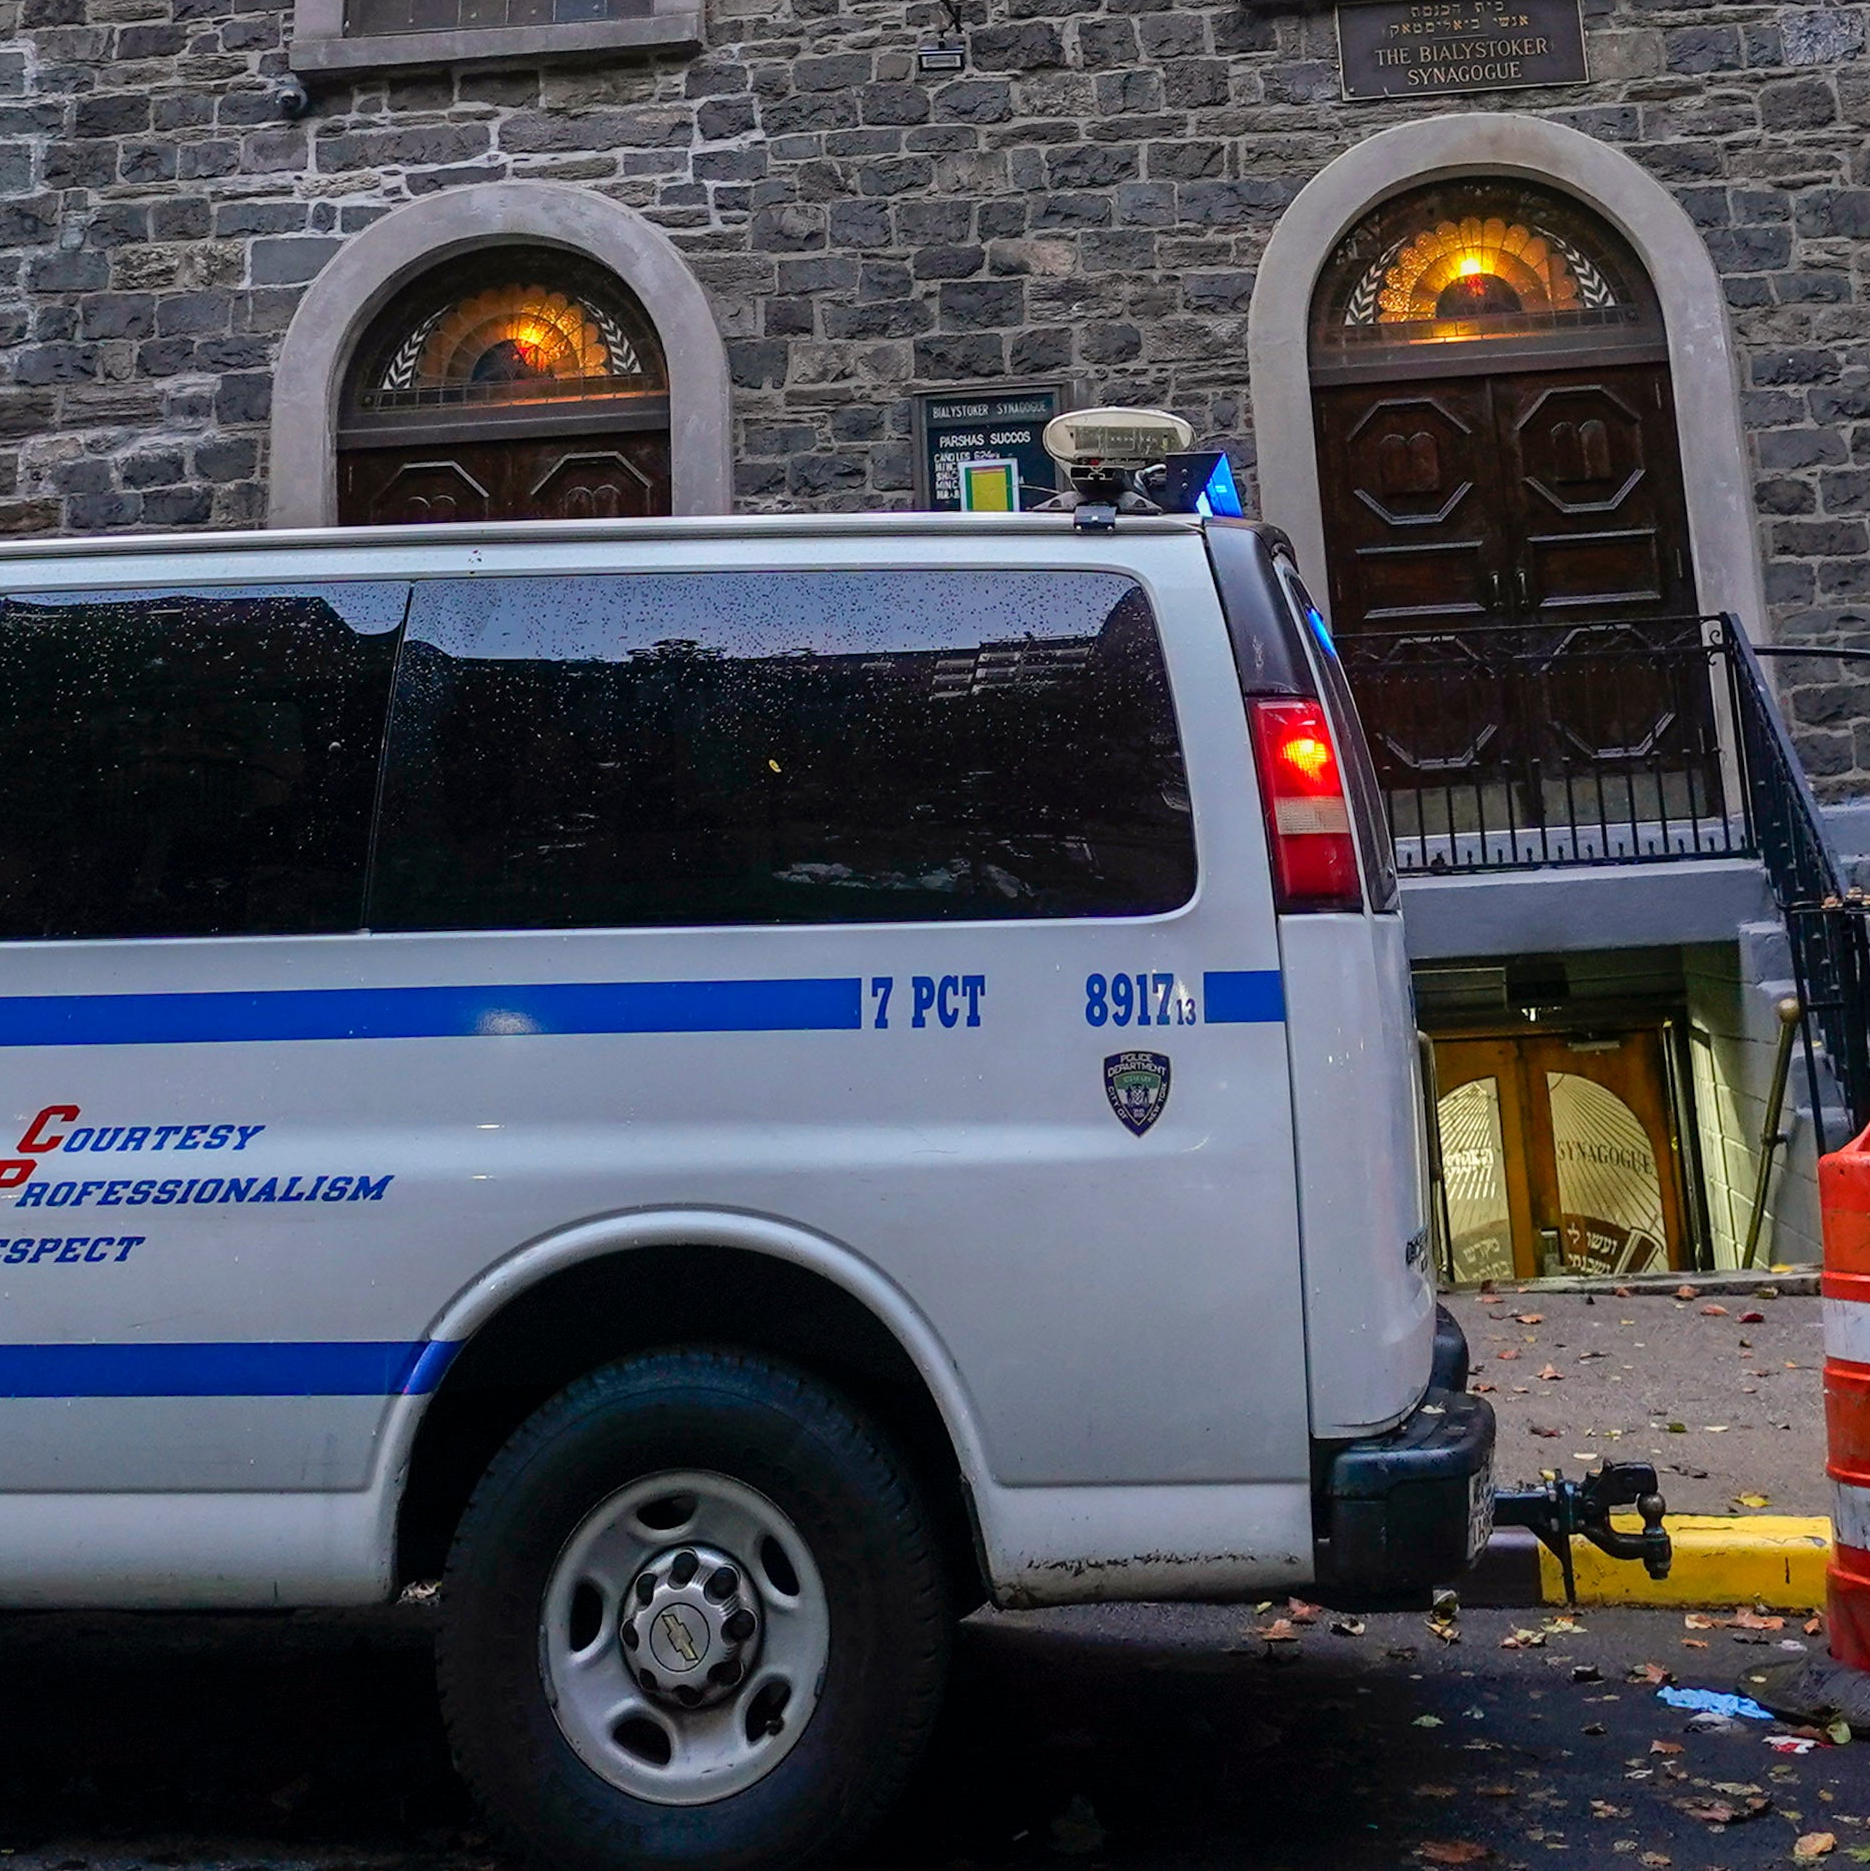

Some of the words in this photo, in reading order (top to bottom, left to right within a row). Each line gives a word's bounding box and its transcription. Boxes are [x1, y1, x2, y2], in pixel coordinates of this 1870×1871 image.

[1375, 48, 1411, 66] THE
[1420, 38, 1548, 63] BIALYSTOKER
[1408, 62, 1522, 86] SYNAGOGUE
[932, 404, 989, 419] BIALYSTOKER
[996, 401, 1047, 415] SYNAGOGUE
[939, 434, 985, 448] PARSHAS
[990, 431, 1031, 445] SUCCOS
[870, 976, 893, 1029] 7
[911, 974, 986, 1028] PCT
[1085, 973, 1174, 1026] 8917
[1107, 1061, 1166, 1078] DEPARTMENT
[1120, 1053, 1153, 1063] POLICE
[1108, 1085, 1121, 1108] CITY
[1147, 1105, 1161, 1123] NEW
[16, 1104, 266, 1154] COURTESY
[1556, 1139, 1655, 1176] SYNAGOGUE
